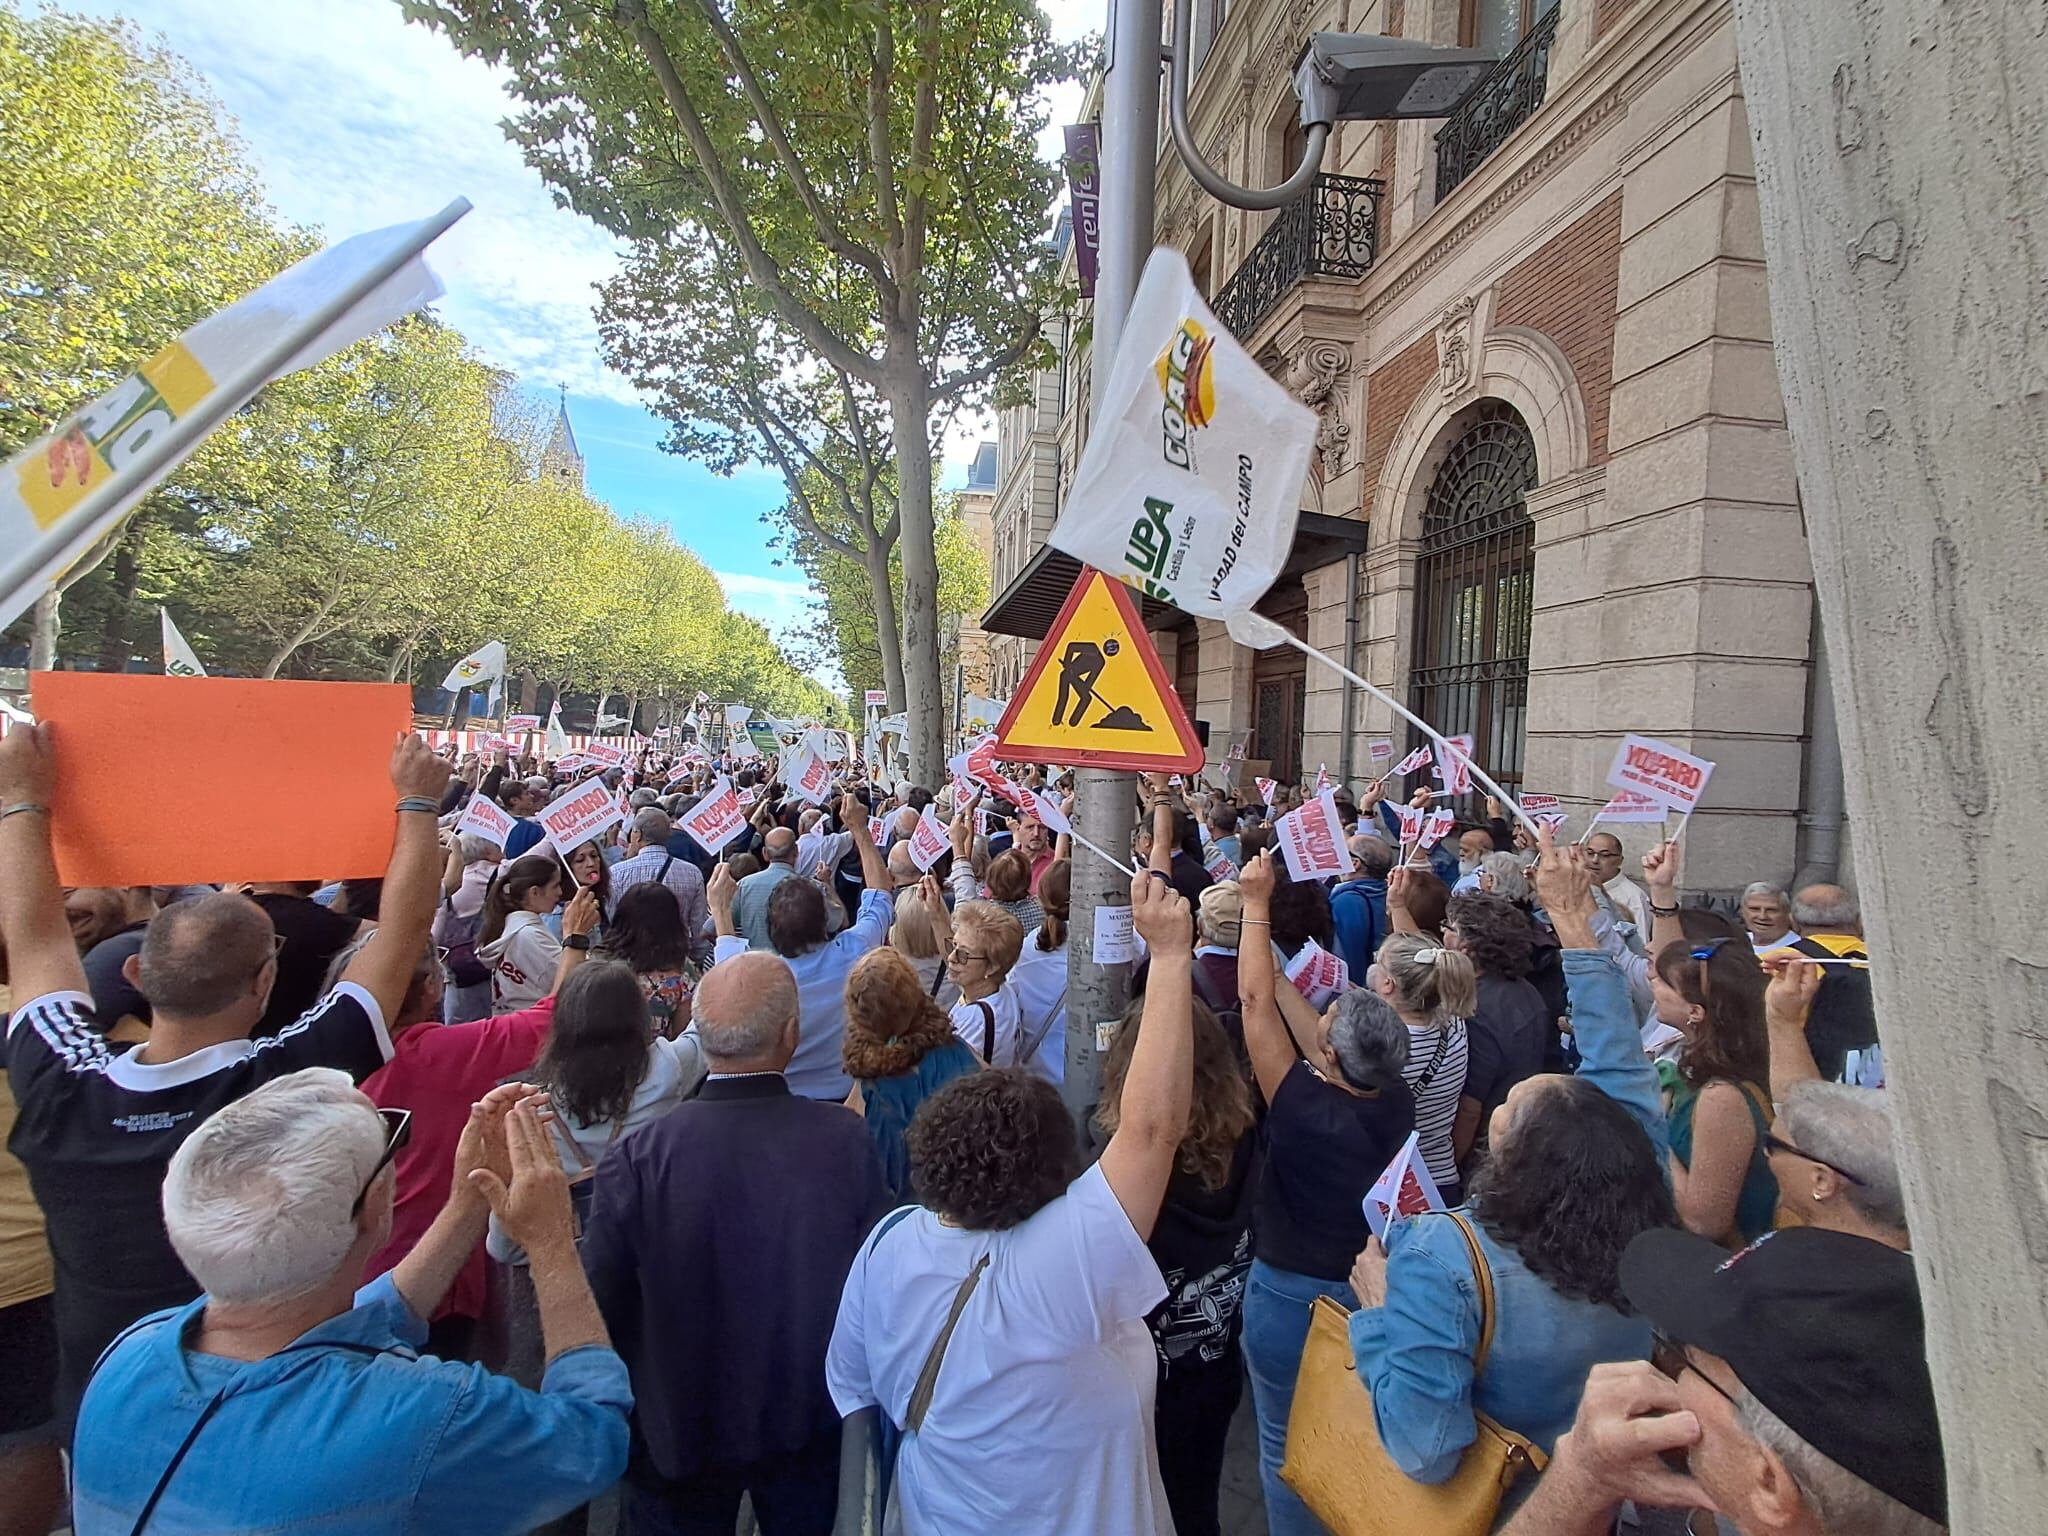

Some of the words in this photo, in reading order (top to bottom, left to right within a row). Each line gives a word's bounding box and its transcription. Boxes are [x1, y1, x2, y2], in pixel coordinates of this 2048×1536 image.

[1072, 175, 1099, 250] renfe
[1162, 329, 1193, 471] COAG
[1238, 454, 1252, 517] CAMPO
[1124, 496, 1174, 579] UPA
[1167, 549, 1185, 580] Castilla
[1179, 516, 1196, 540] León
[1231, 516, 1246, 548] del
[167, 659, 203, 676] UP
